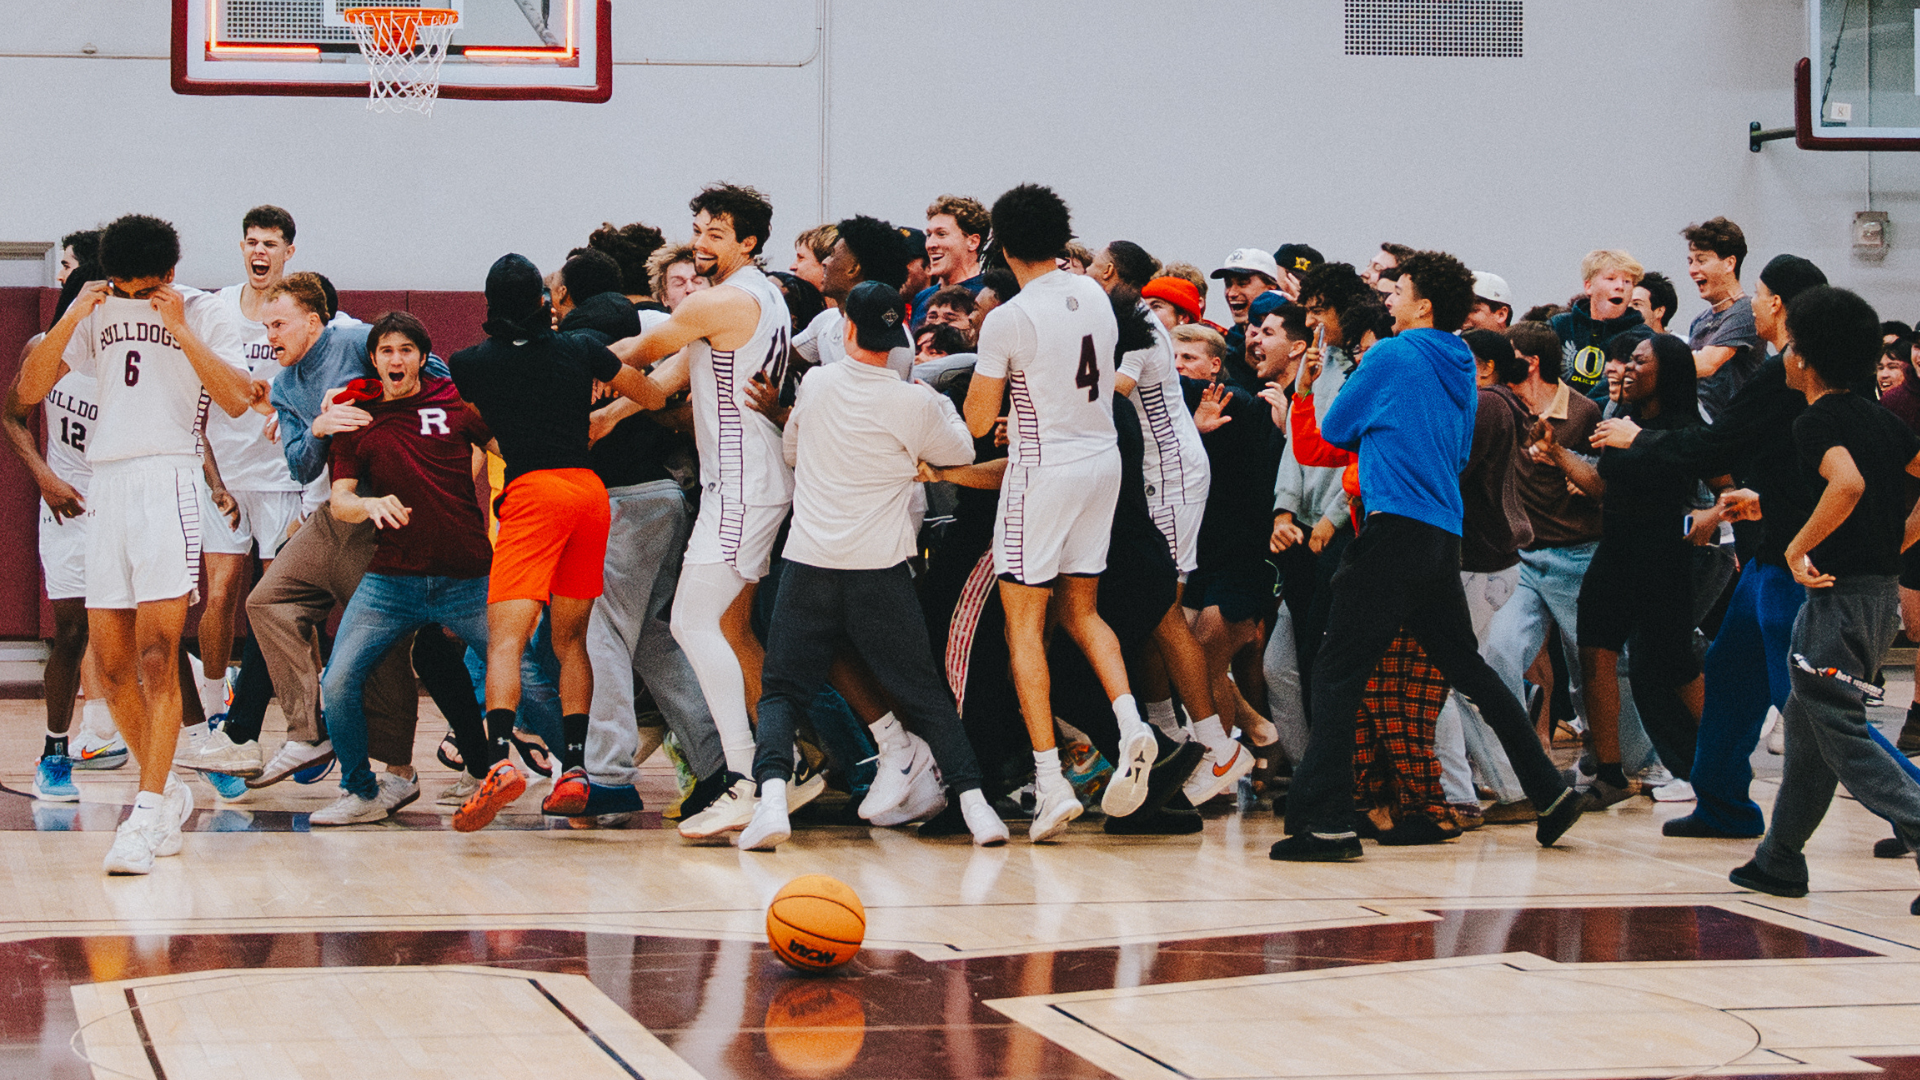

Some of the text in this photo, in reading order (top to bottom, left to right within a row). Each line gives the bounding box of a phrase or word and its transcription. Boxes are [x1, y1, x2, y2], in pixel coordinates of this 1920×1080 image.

[124, 350, 142, 387] 6
[1075, 334, 1100, 403] 4
[45, 389, 99, 421] ULLDO
[417, 407, 451, 435] R
[60, 416, 87, 453] 12
[1835, 669, 1853, 684] hot
[1853, 679, 1883, 695] moms
[788, 939, 837, 964] NCAA
